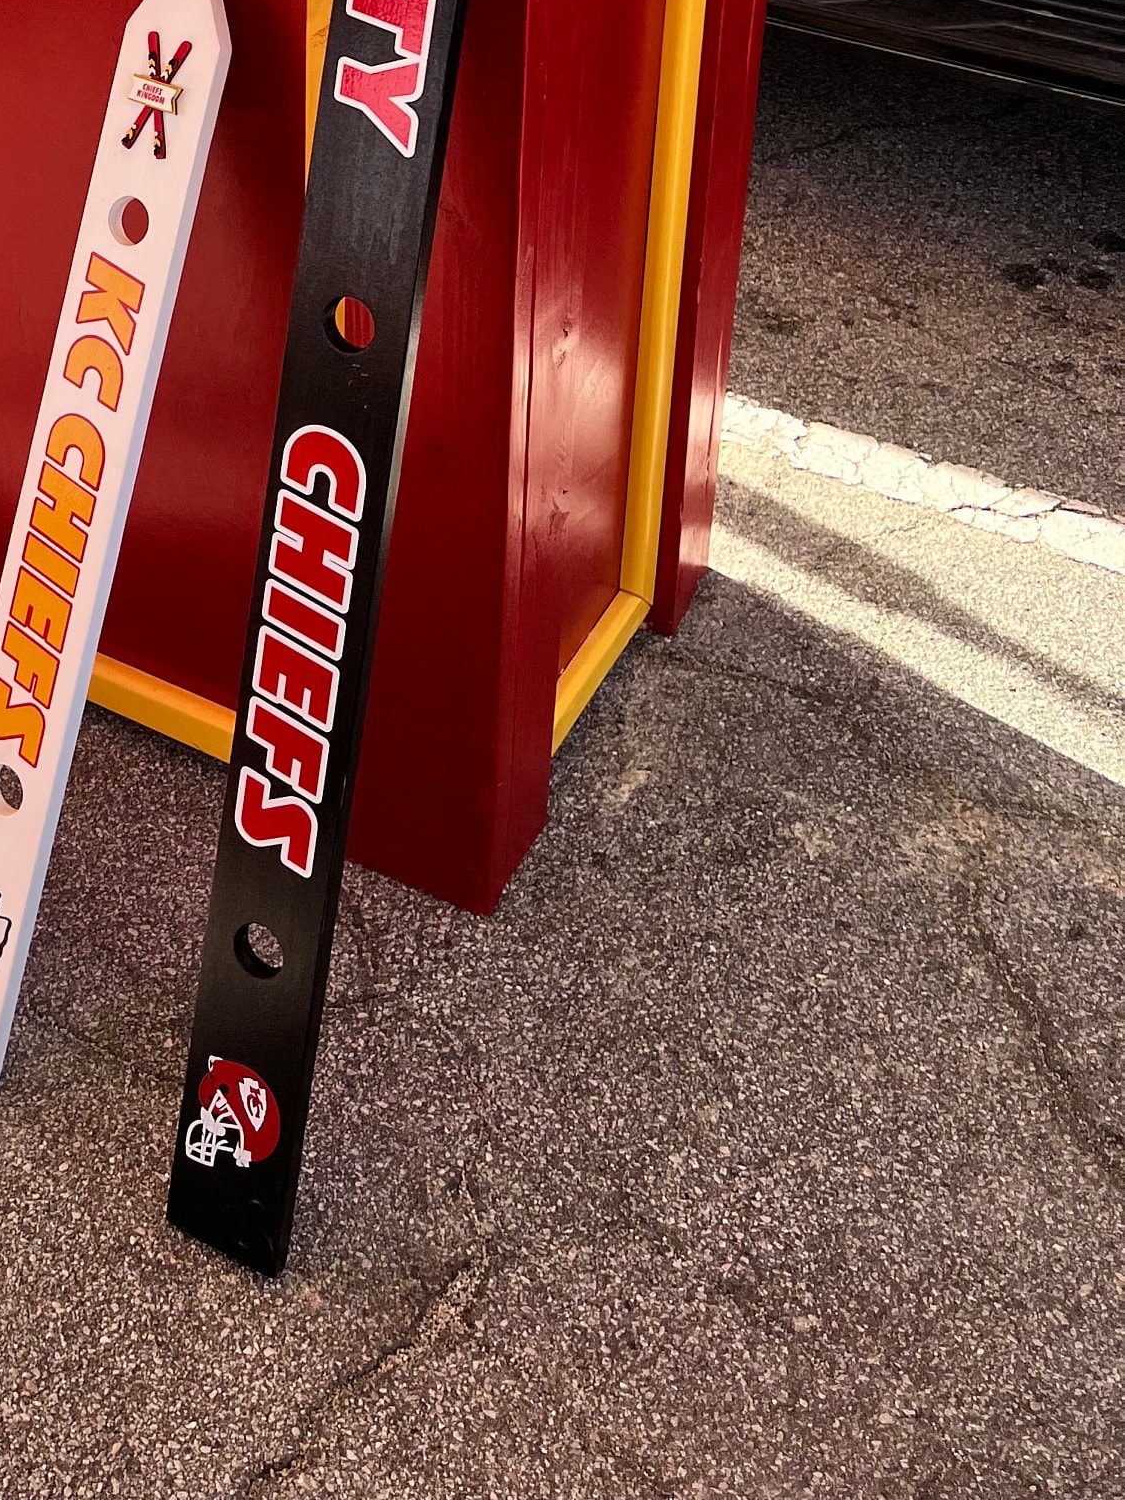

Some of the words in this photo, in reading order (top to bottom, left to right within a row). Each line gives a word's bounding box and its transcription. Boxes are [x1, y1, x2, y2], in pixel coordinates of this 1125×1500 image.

[136, 89, 165, 105] KINGDOM
[142, 83, 163, 96] CHIEFS
[63, 252, 145, 412] KC
[234, 424, 367, 878] CHIEFS
